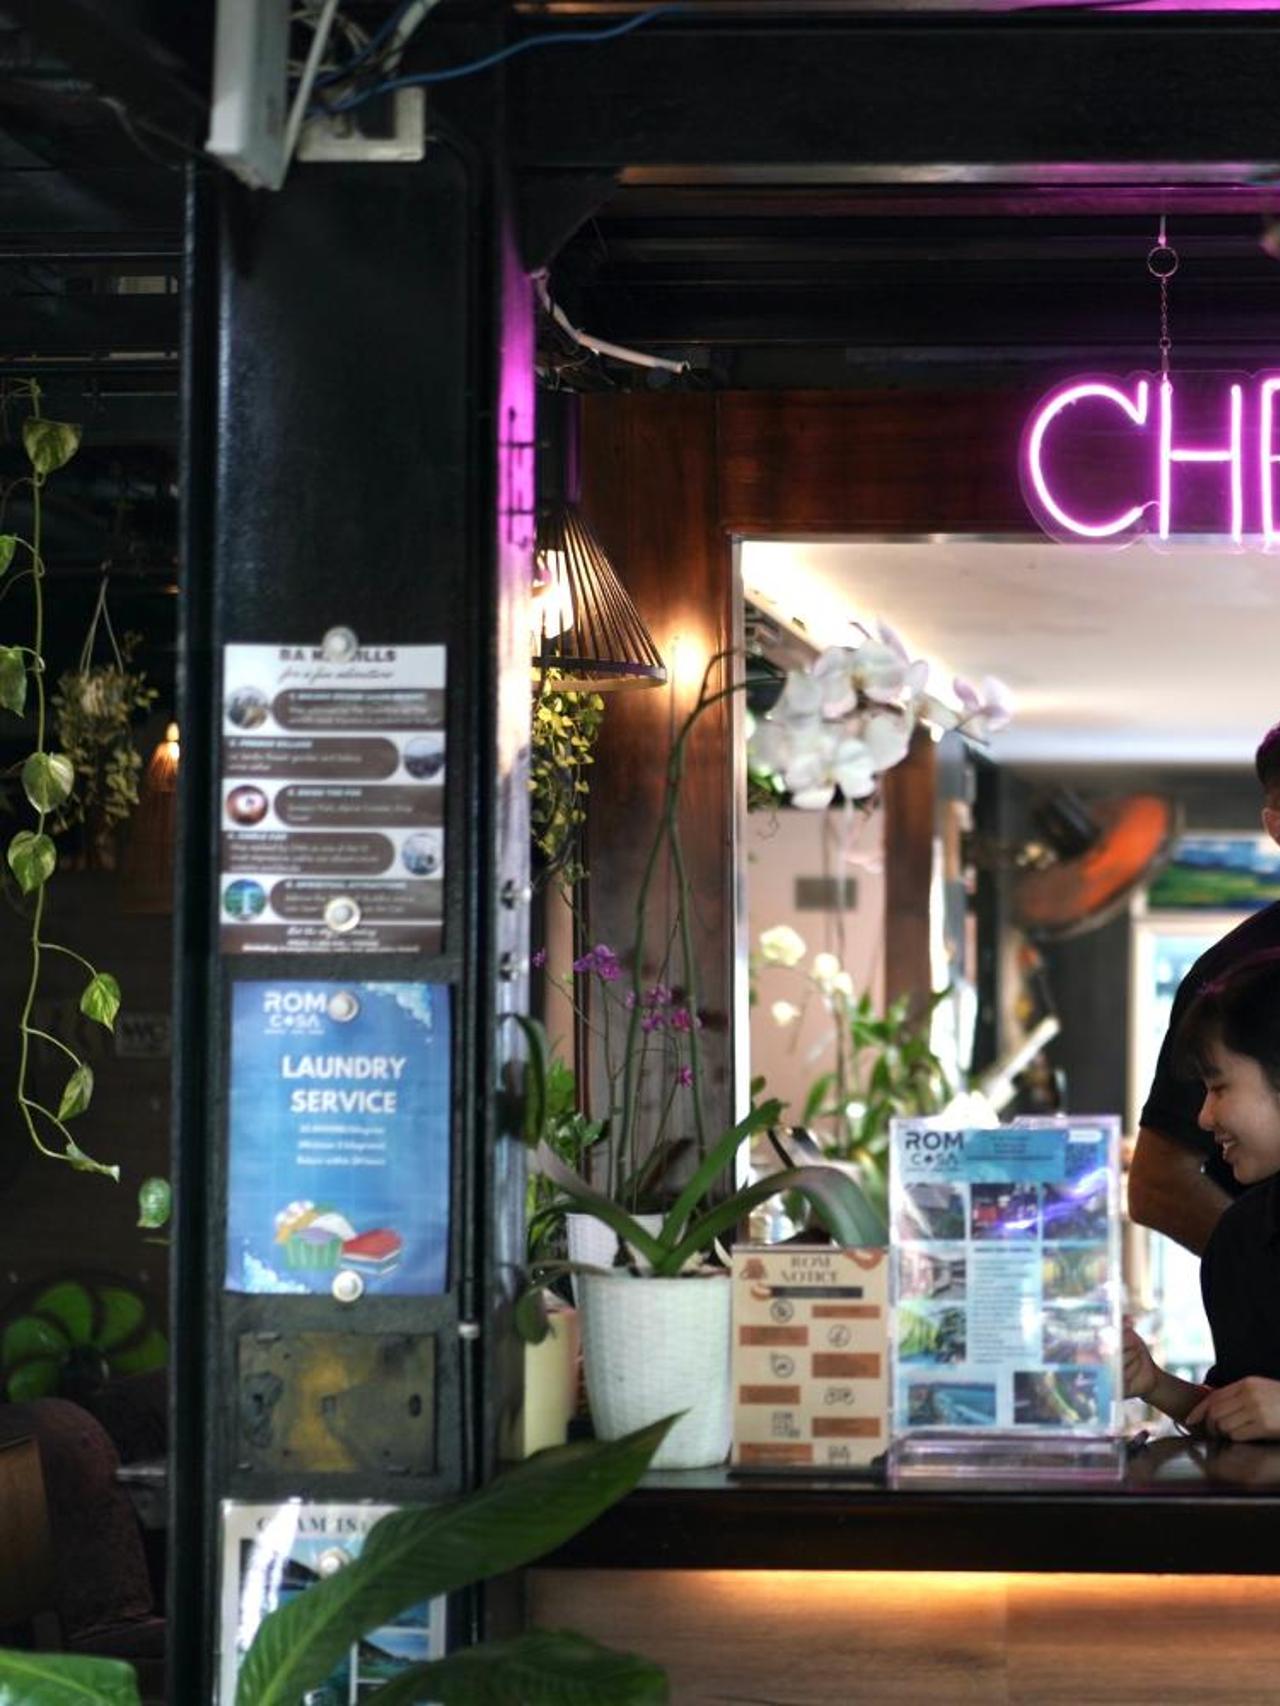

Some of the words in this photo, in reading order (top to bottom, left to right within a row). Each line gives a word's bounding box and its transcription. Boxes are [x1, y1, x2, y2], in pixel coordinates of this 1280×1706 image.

[262, 990, 327, 1014] ROM
[282, 1055, 406, 1080] LAUNDRY
[290, 1090, 398, 1114] SERVICE
[904, 1131, 964, 1150] ROM
